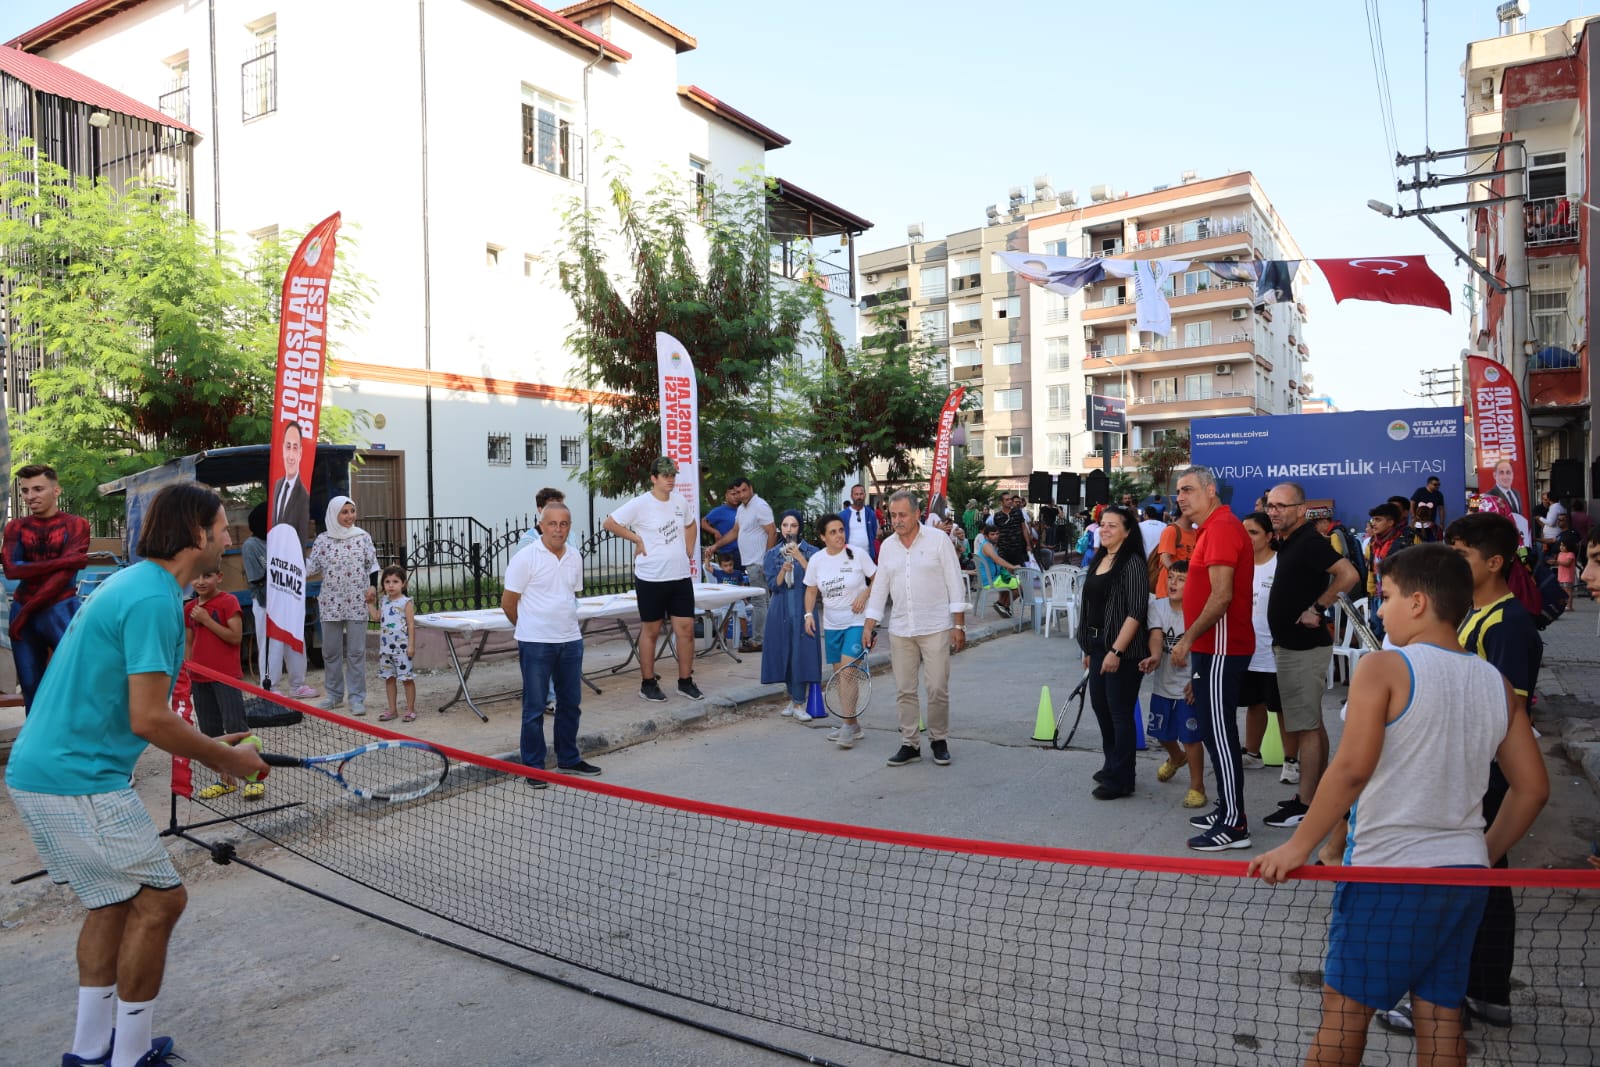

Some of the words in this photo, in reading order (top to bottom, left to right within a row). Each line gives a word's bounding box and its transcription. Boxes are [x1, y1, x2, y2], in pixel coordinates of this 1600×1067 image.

[280, 275, 309, 423] TOROSLAR
[298, 277, 327, 439] BELEDİYESİ
[1195, 432, 1230, 440] TOROSLAR
[1231, 430, 1269, 439] BELEDİYESİ
[1412, 425, 1457, 435] YILMAZ
[1208, 465, 1264, 479] AVRUPA
[1267, 459, 1374, 477] HAREKETLİLİK
[1379, 460, 1446, 474] HAFTASI
[270, 569, 302, 596] YILMAZ
